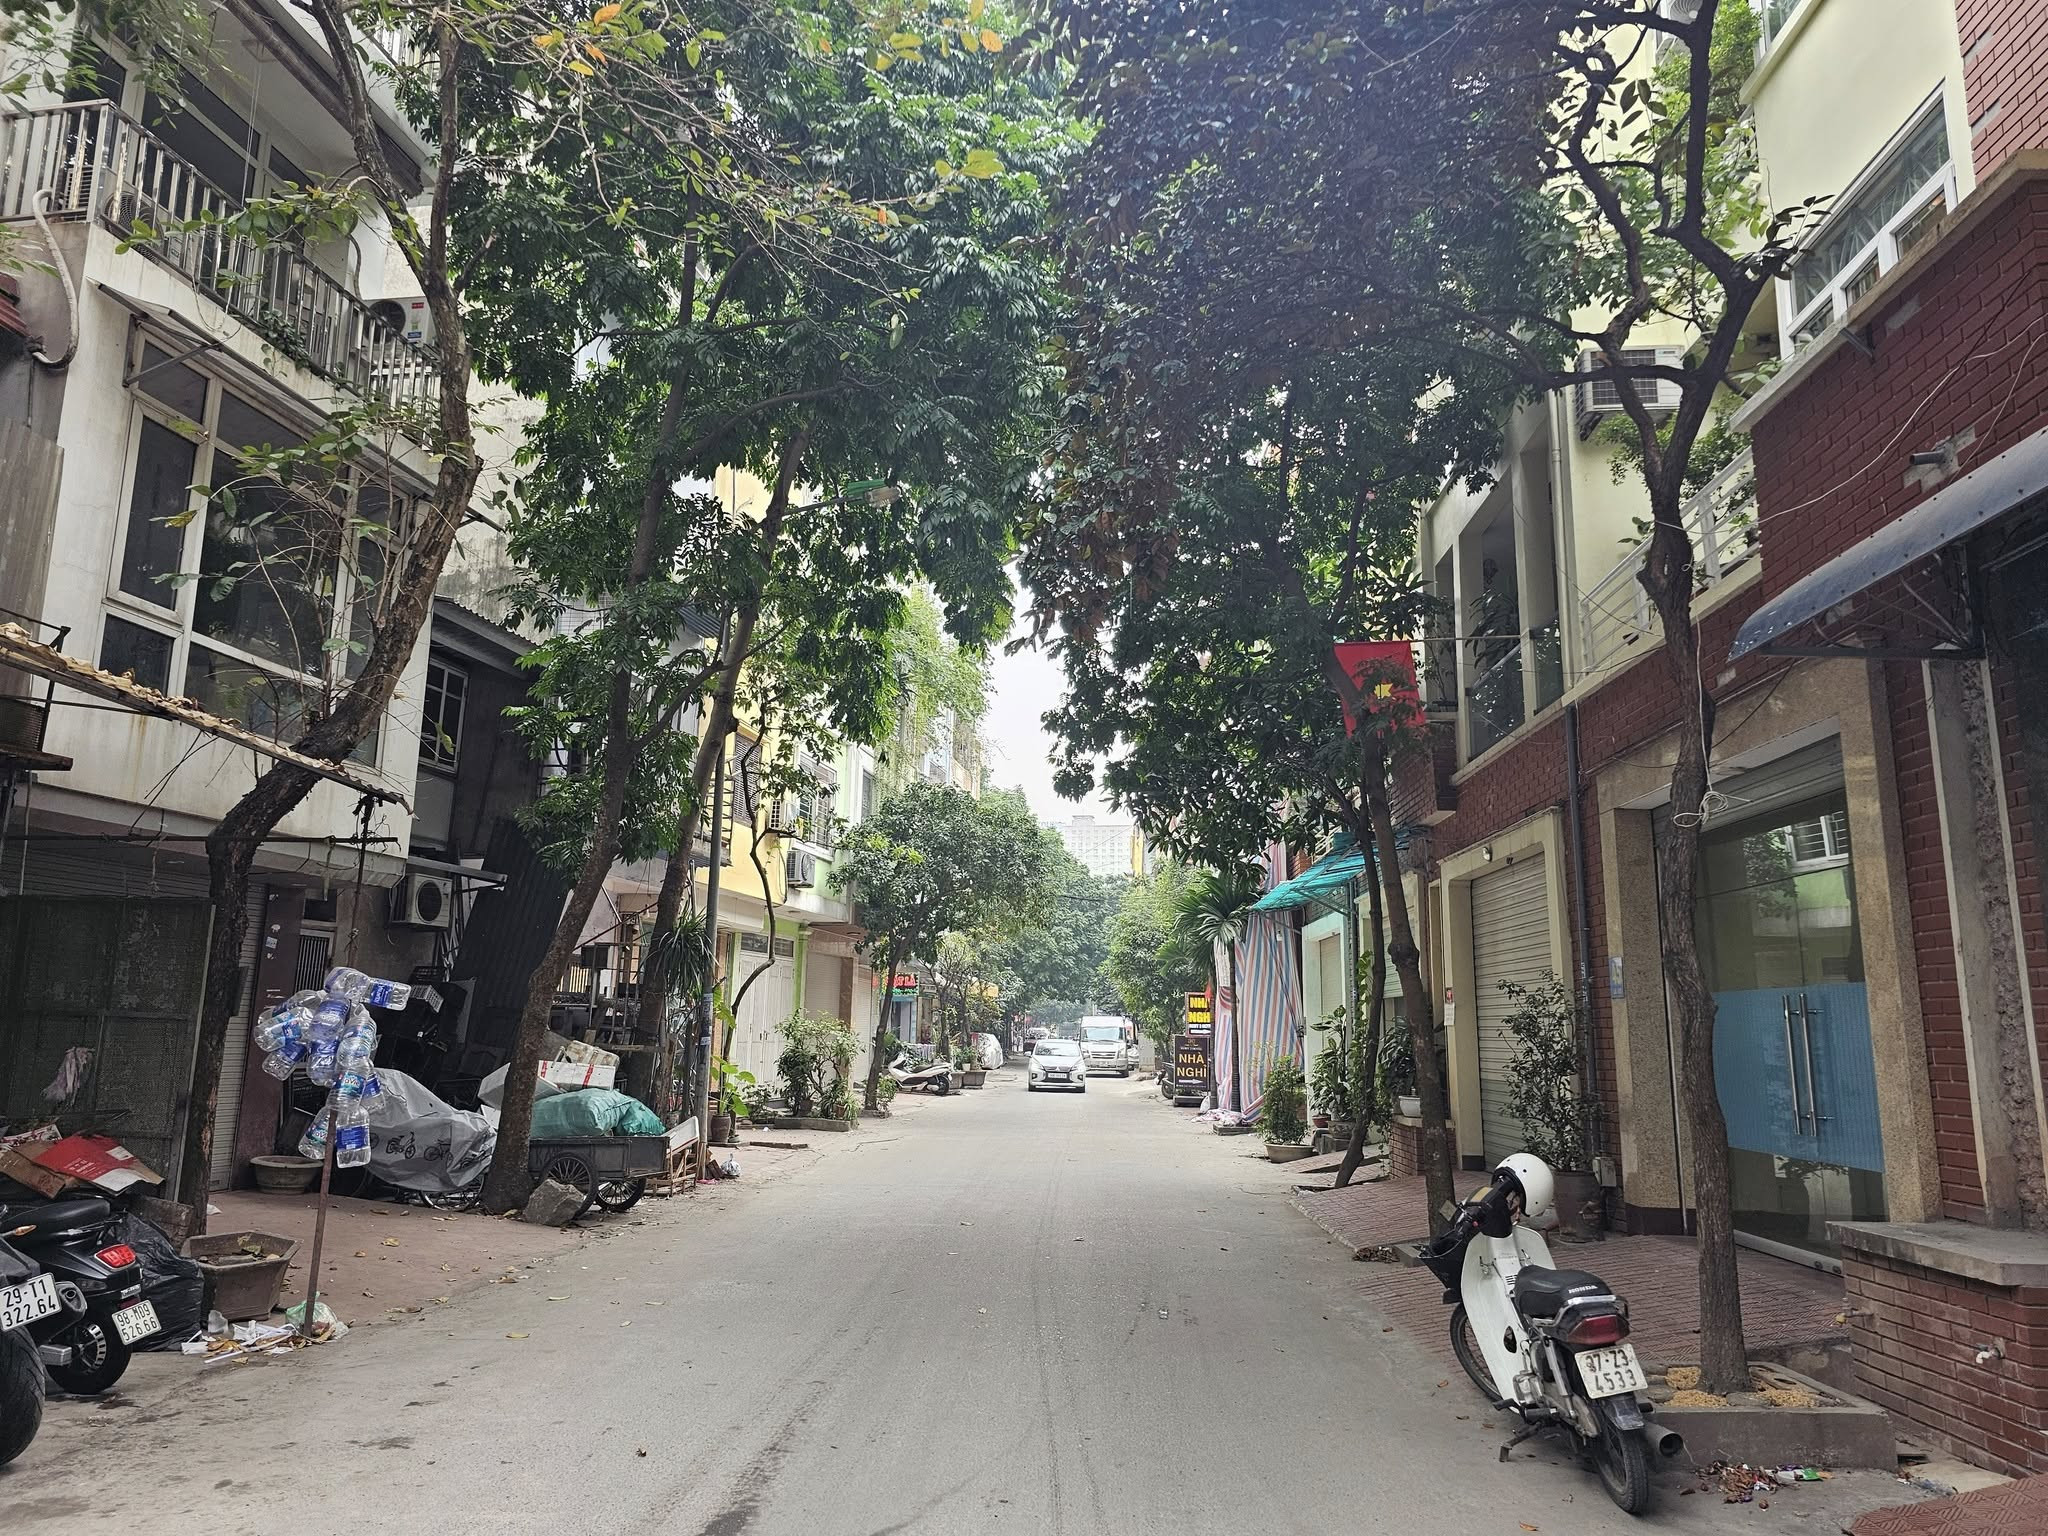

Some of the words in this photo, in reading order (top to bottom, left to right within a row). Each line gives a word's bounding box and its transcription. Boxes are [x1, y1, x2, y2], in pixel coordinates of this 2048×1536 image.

[1179, 1051, 1205, 1064] NHÀ
[3, 1278, 47, 1308] 29-T1
[1568, 1285, 1598, 1294] HONDA
[2, 1295, 57, 1328] 322.64
[121, 1316, 158, 1341] 526.66
[1594, 1369, 1637, 1393] 4533
